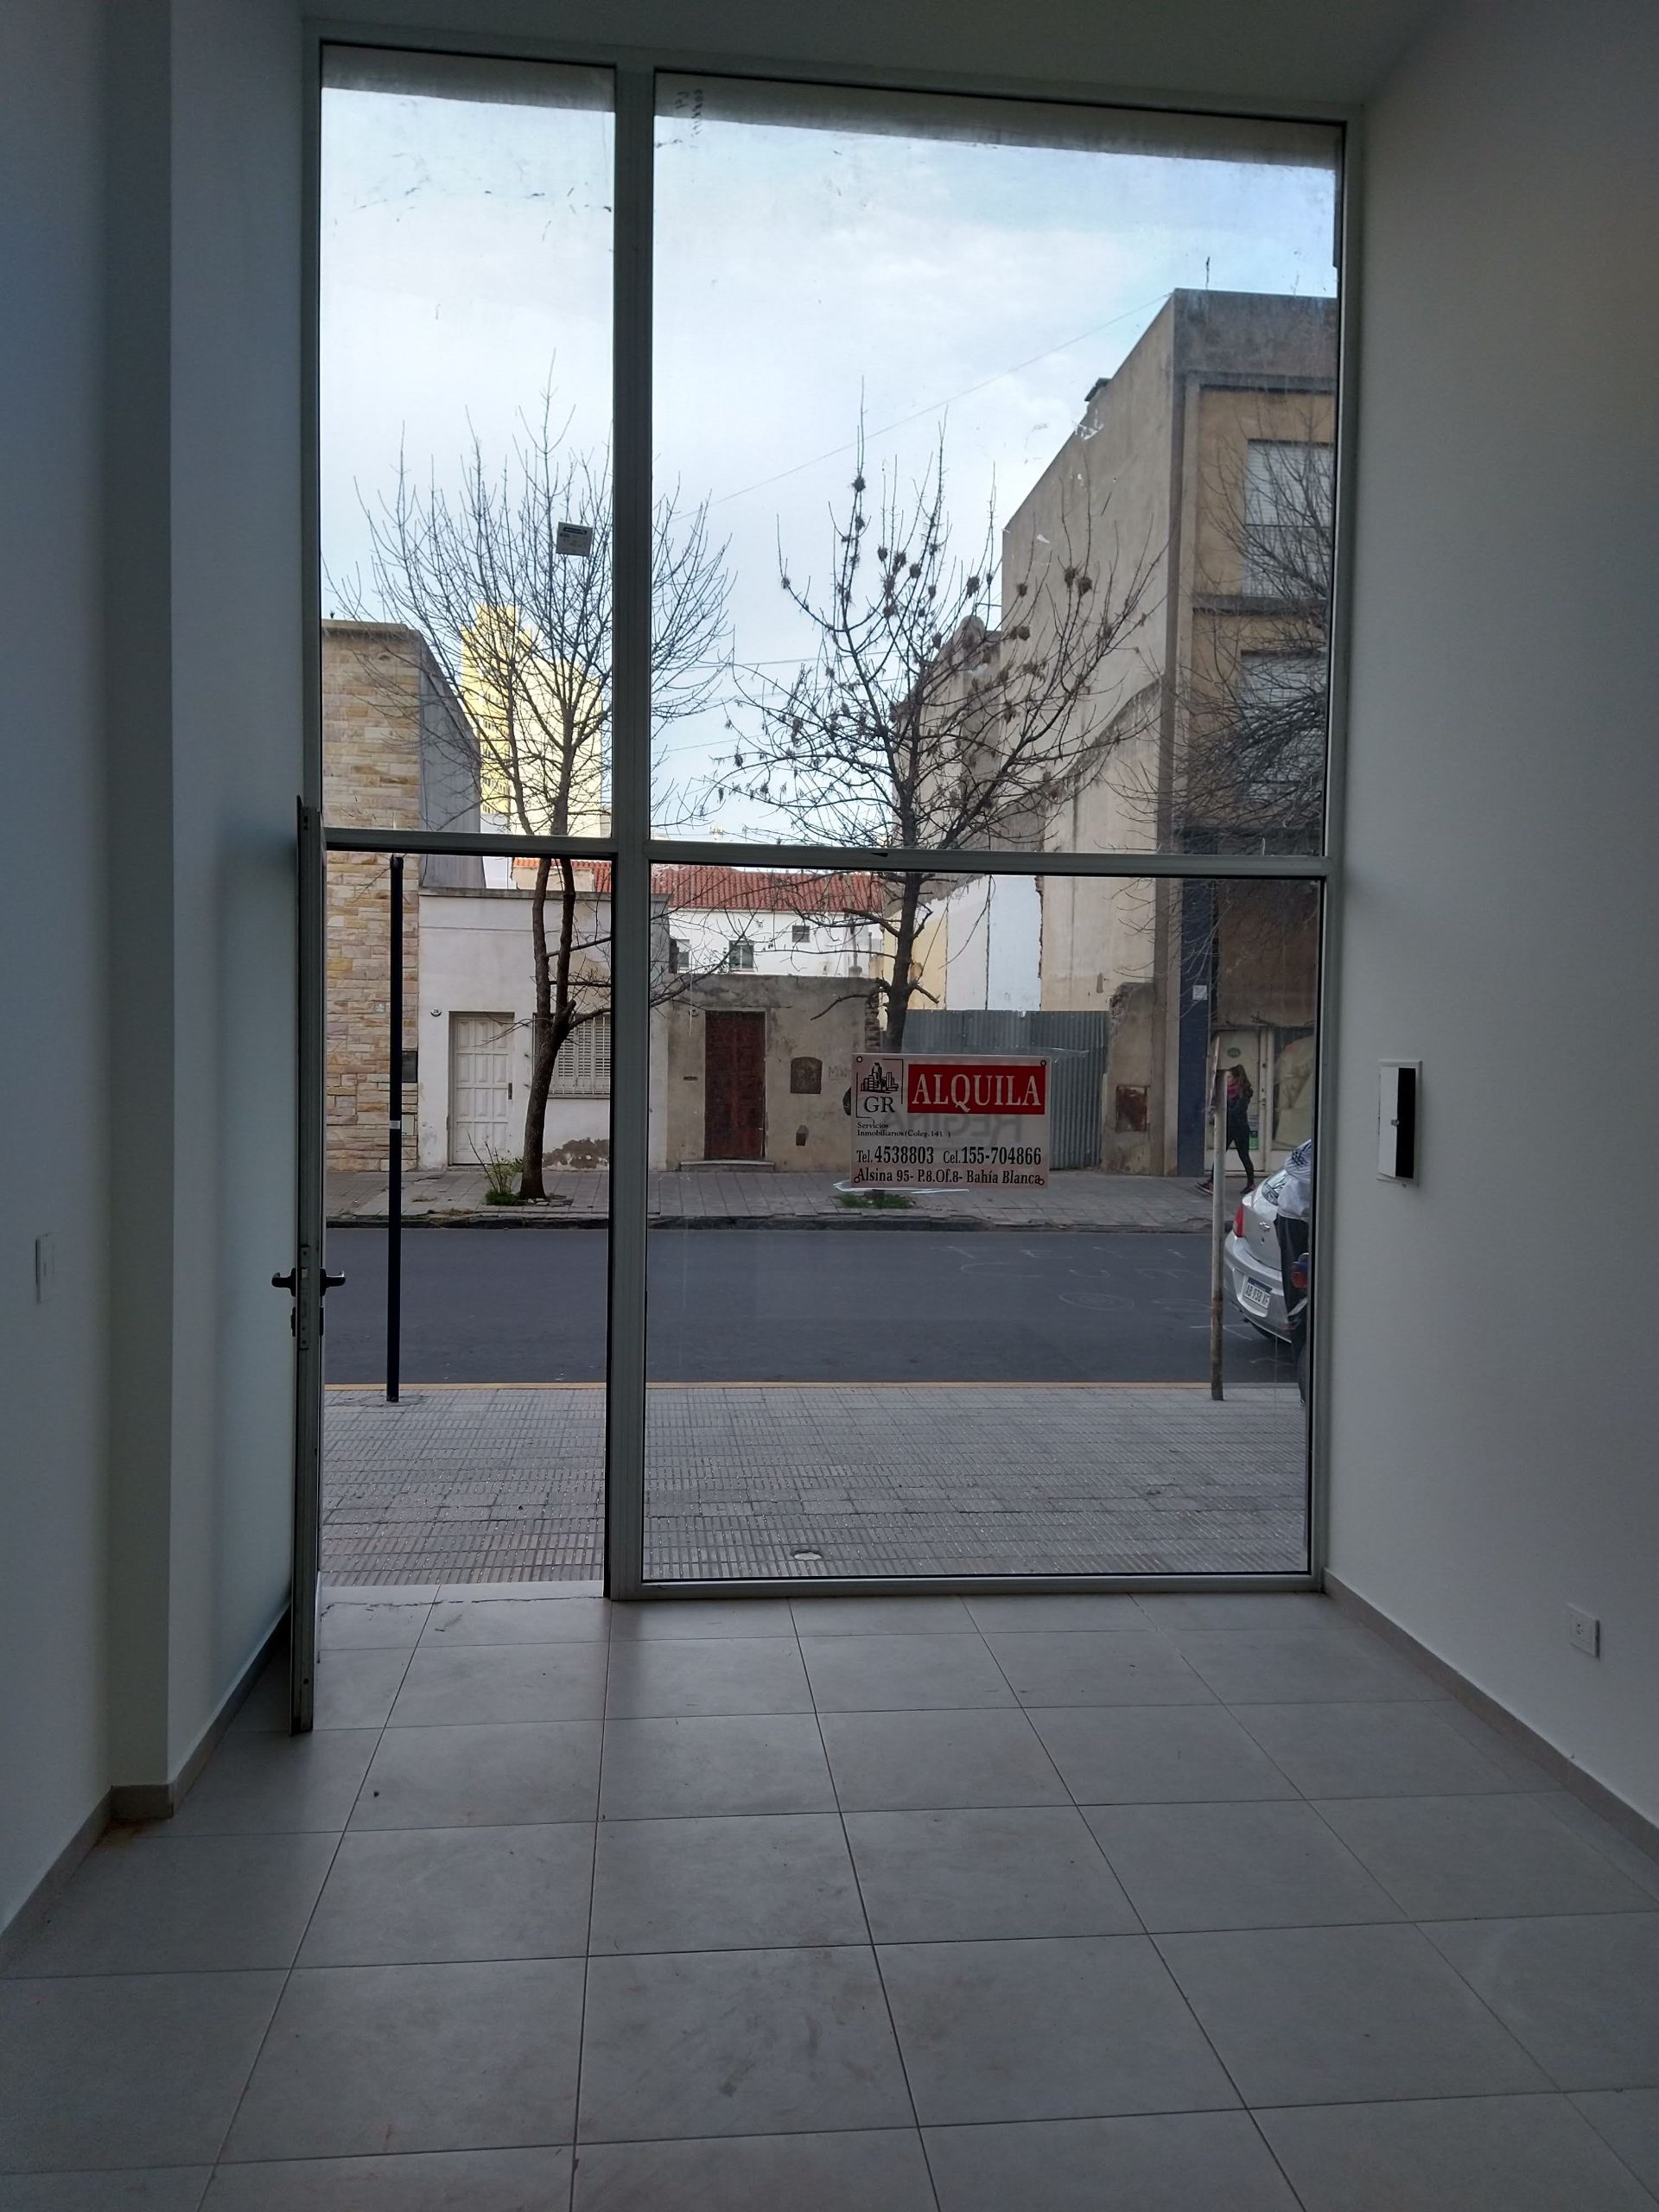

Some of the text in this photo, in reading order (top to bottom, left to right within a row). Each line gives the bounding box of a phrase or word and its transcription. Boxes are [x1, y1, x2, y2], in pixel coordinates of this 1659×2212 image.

[912, 1073, 1042, 1113] ALQUILA
[864, 1096, 895, 1114] GR
[874, 1146, 934, 1164] 4538803
[962, 1147, 1042, 1165] 155-704866
[857, 1167, 893, 1182] Alsina
[967, 1169, 999, 1184] Bahía
[1001, 1170, 1041, 1185] Blanca
